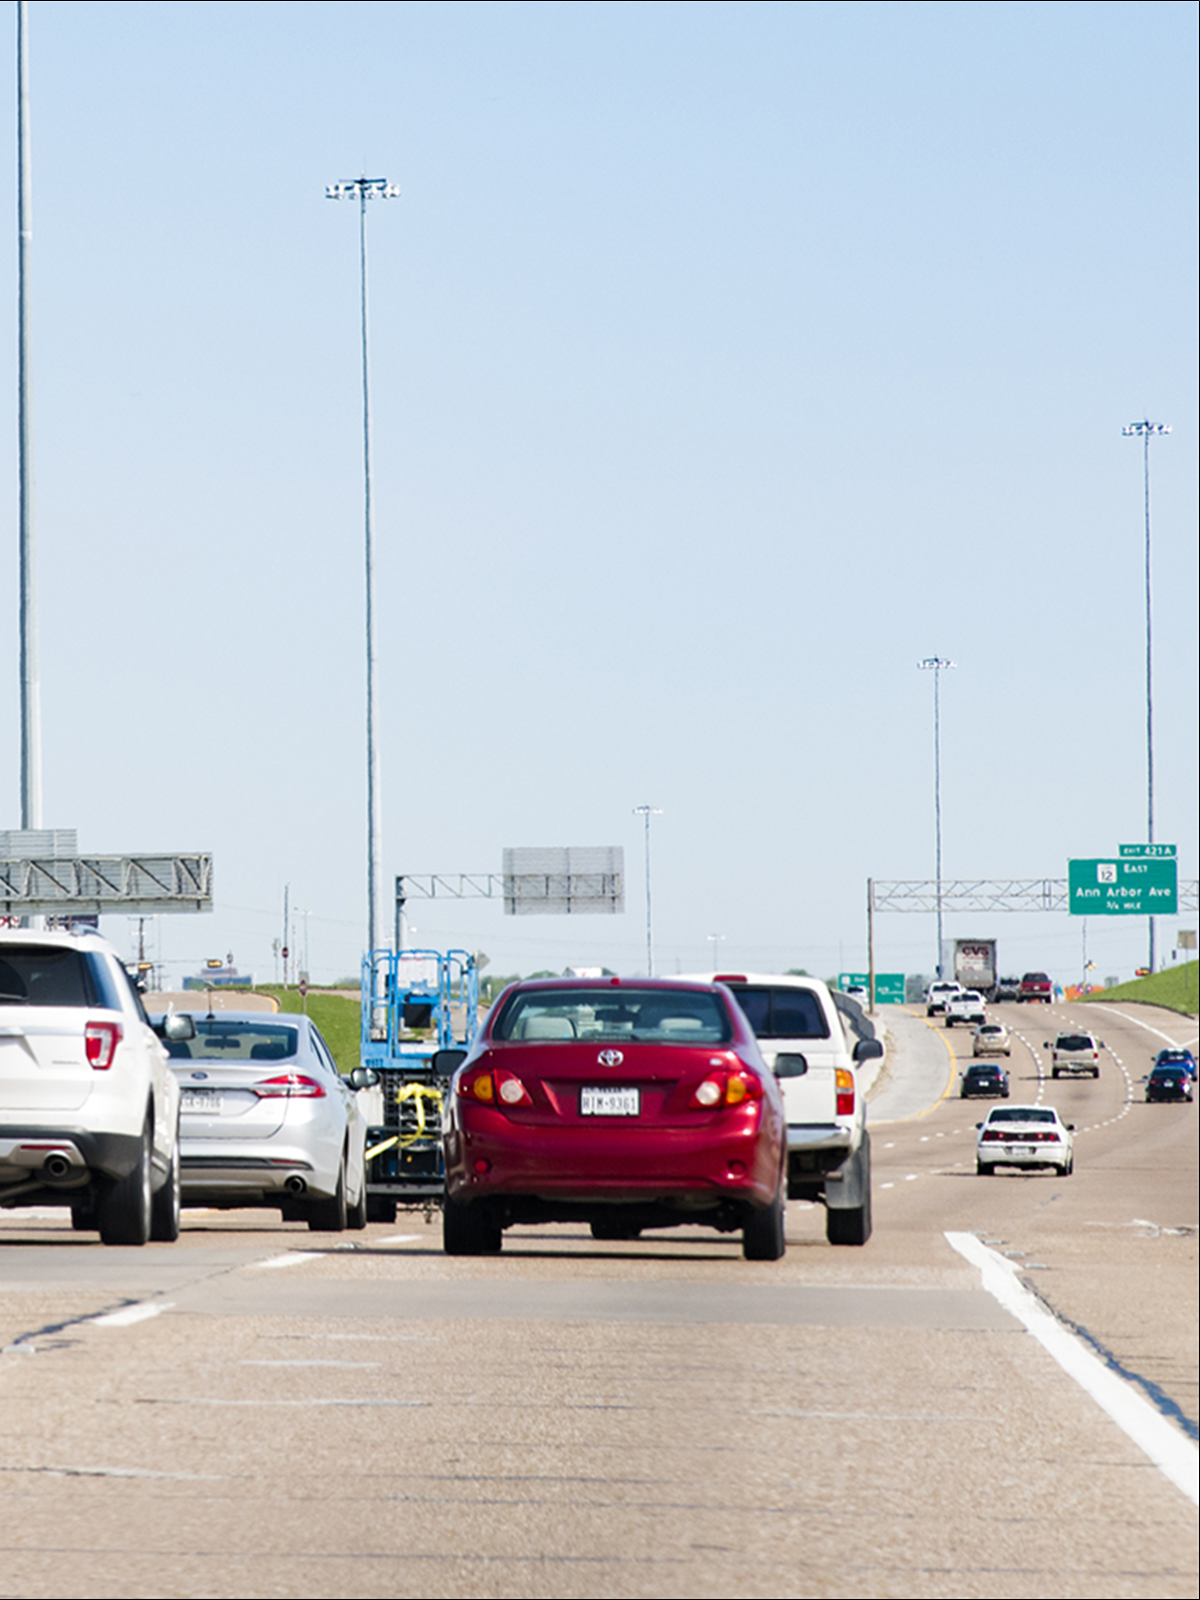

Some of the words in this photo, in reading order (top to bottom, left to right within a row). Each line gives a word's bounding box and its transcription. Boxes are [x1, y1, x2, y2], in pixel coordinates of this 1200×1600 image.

[1123, 847, 1141, 855] EXIT
[1123, 863, 1148, 873] EAST
[1101, 870, 1113, 881] 12
[1075, 887, 1100, 898] Ann
[1106, 886, 1143, 898] Arbor
[1148, 887, 1171, 897] Ave
[1123, 902, 1141, 910] MILE
[962, 946, 990, 956] CVS
